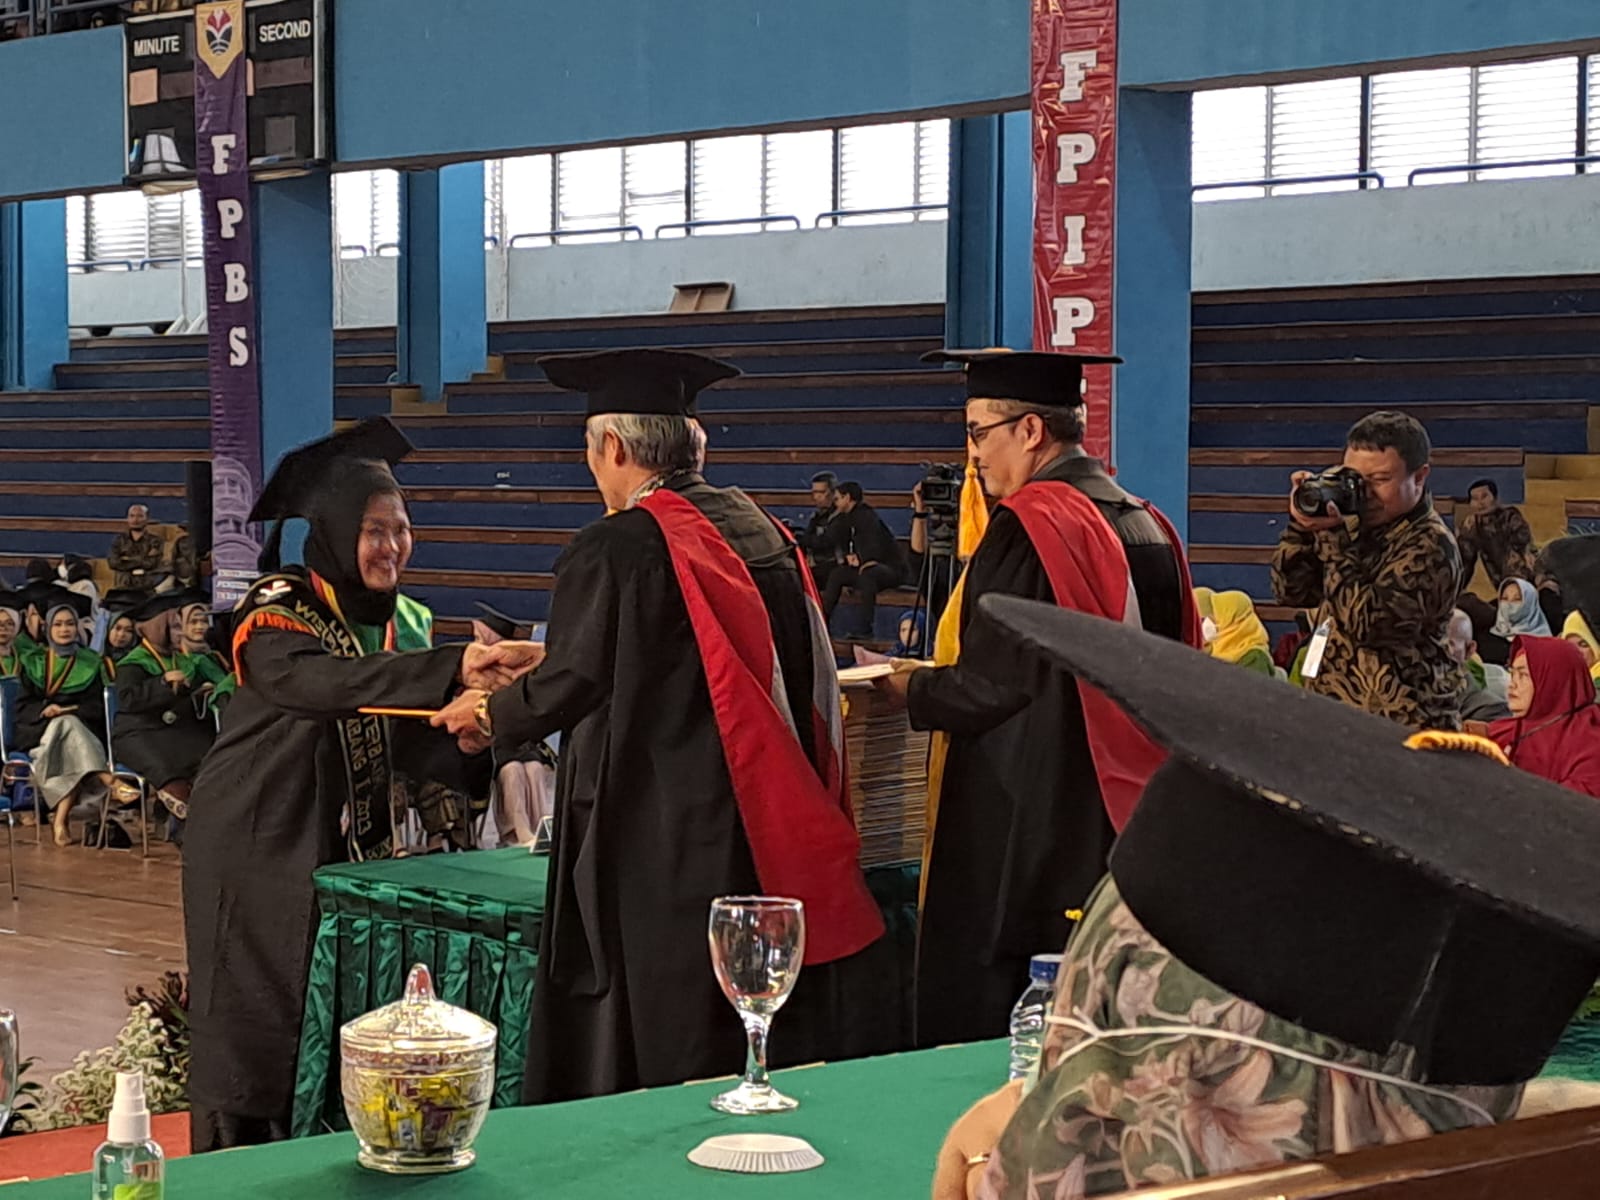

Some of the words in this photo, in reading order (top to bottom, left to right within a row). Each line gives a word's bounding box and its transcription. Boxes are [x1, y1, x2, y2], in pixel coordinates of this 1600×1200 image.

[259, 20, 311, 42] SECOND
[134, 35, 180, 57] MINUTE
[1050, 50, 1097, 424] FPIP
